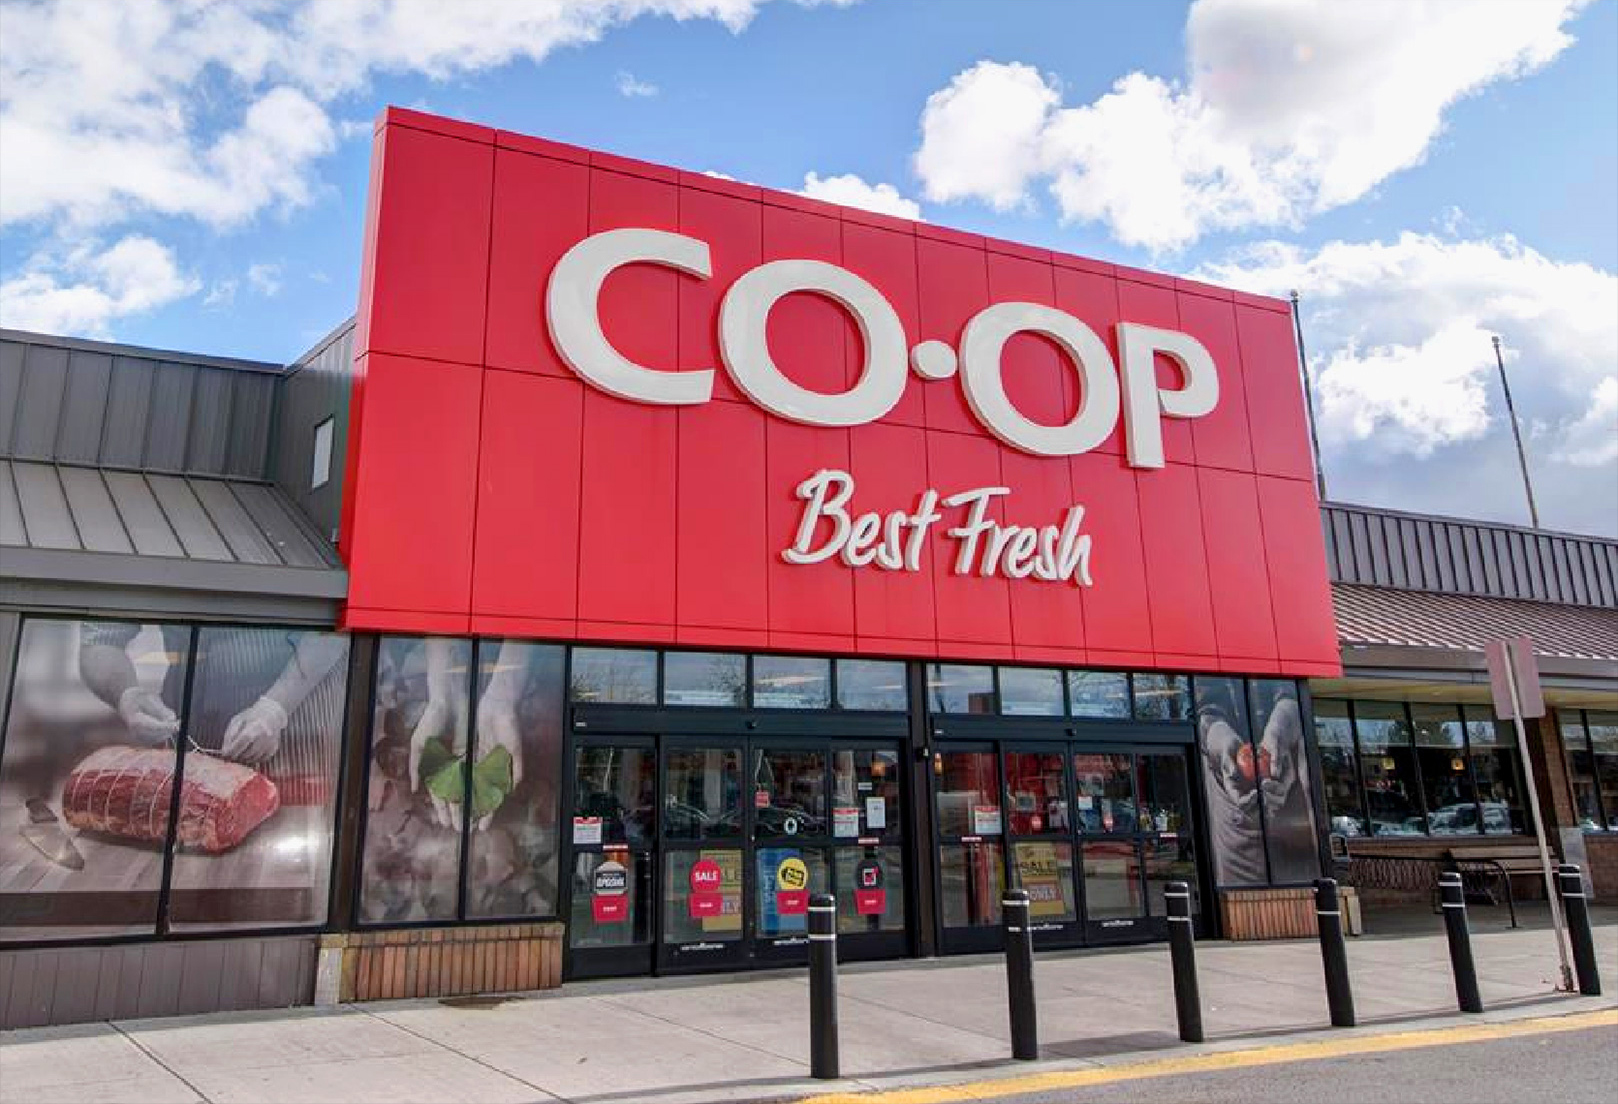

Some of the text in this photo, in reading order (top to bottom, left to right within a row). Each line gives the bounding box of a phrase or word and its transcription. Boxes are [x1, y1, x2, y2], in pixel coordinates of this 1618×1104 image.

[782, 470, 1093, 586] Best Fresh
[695, 870, 718, 881] SALE
